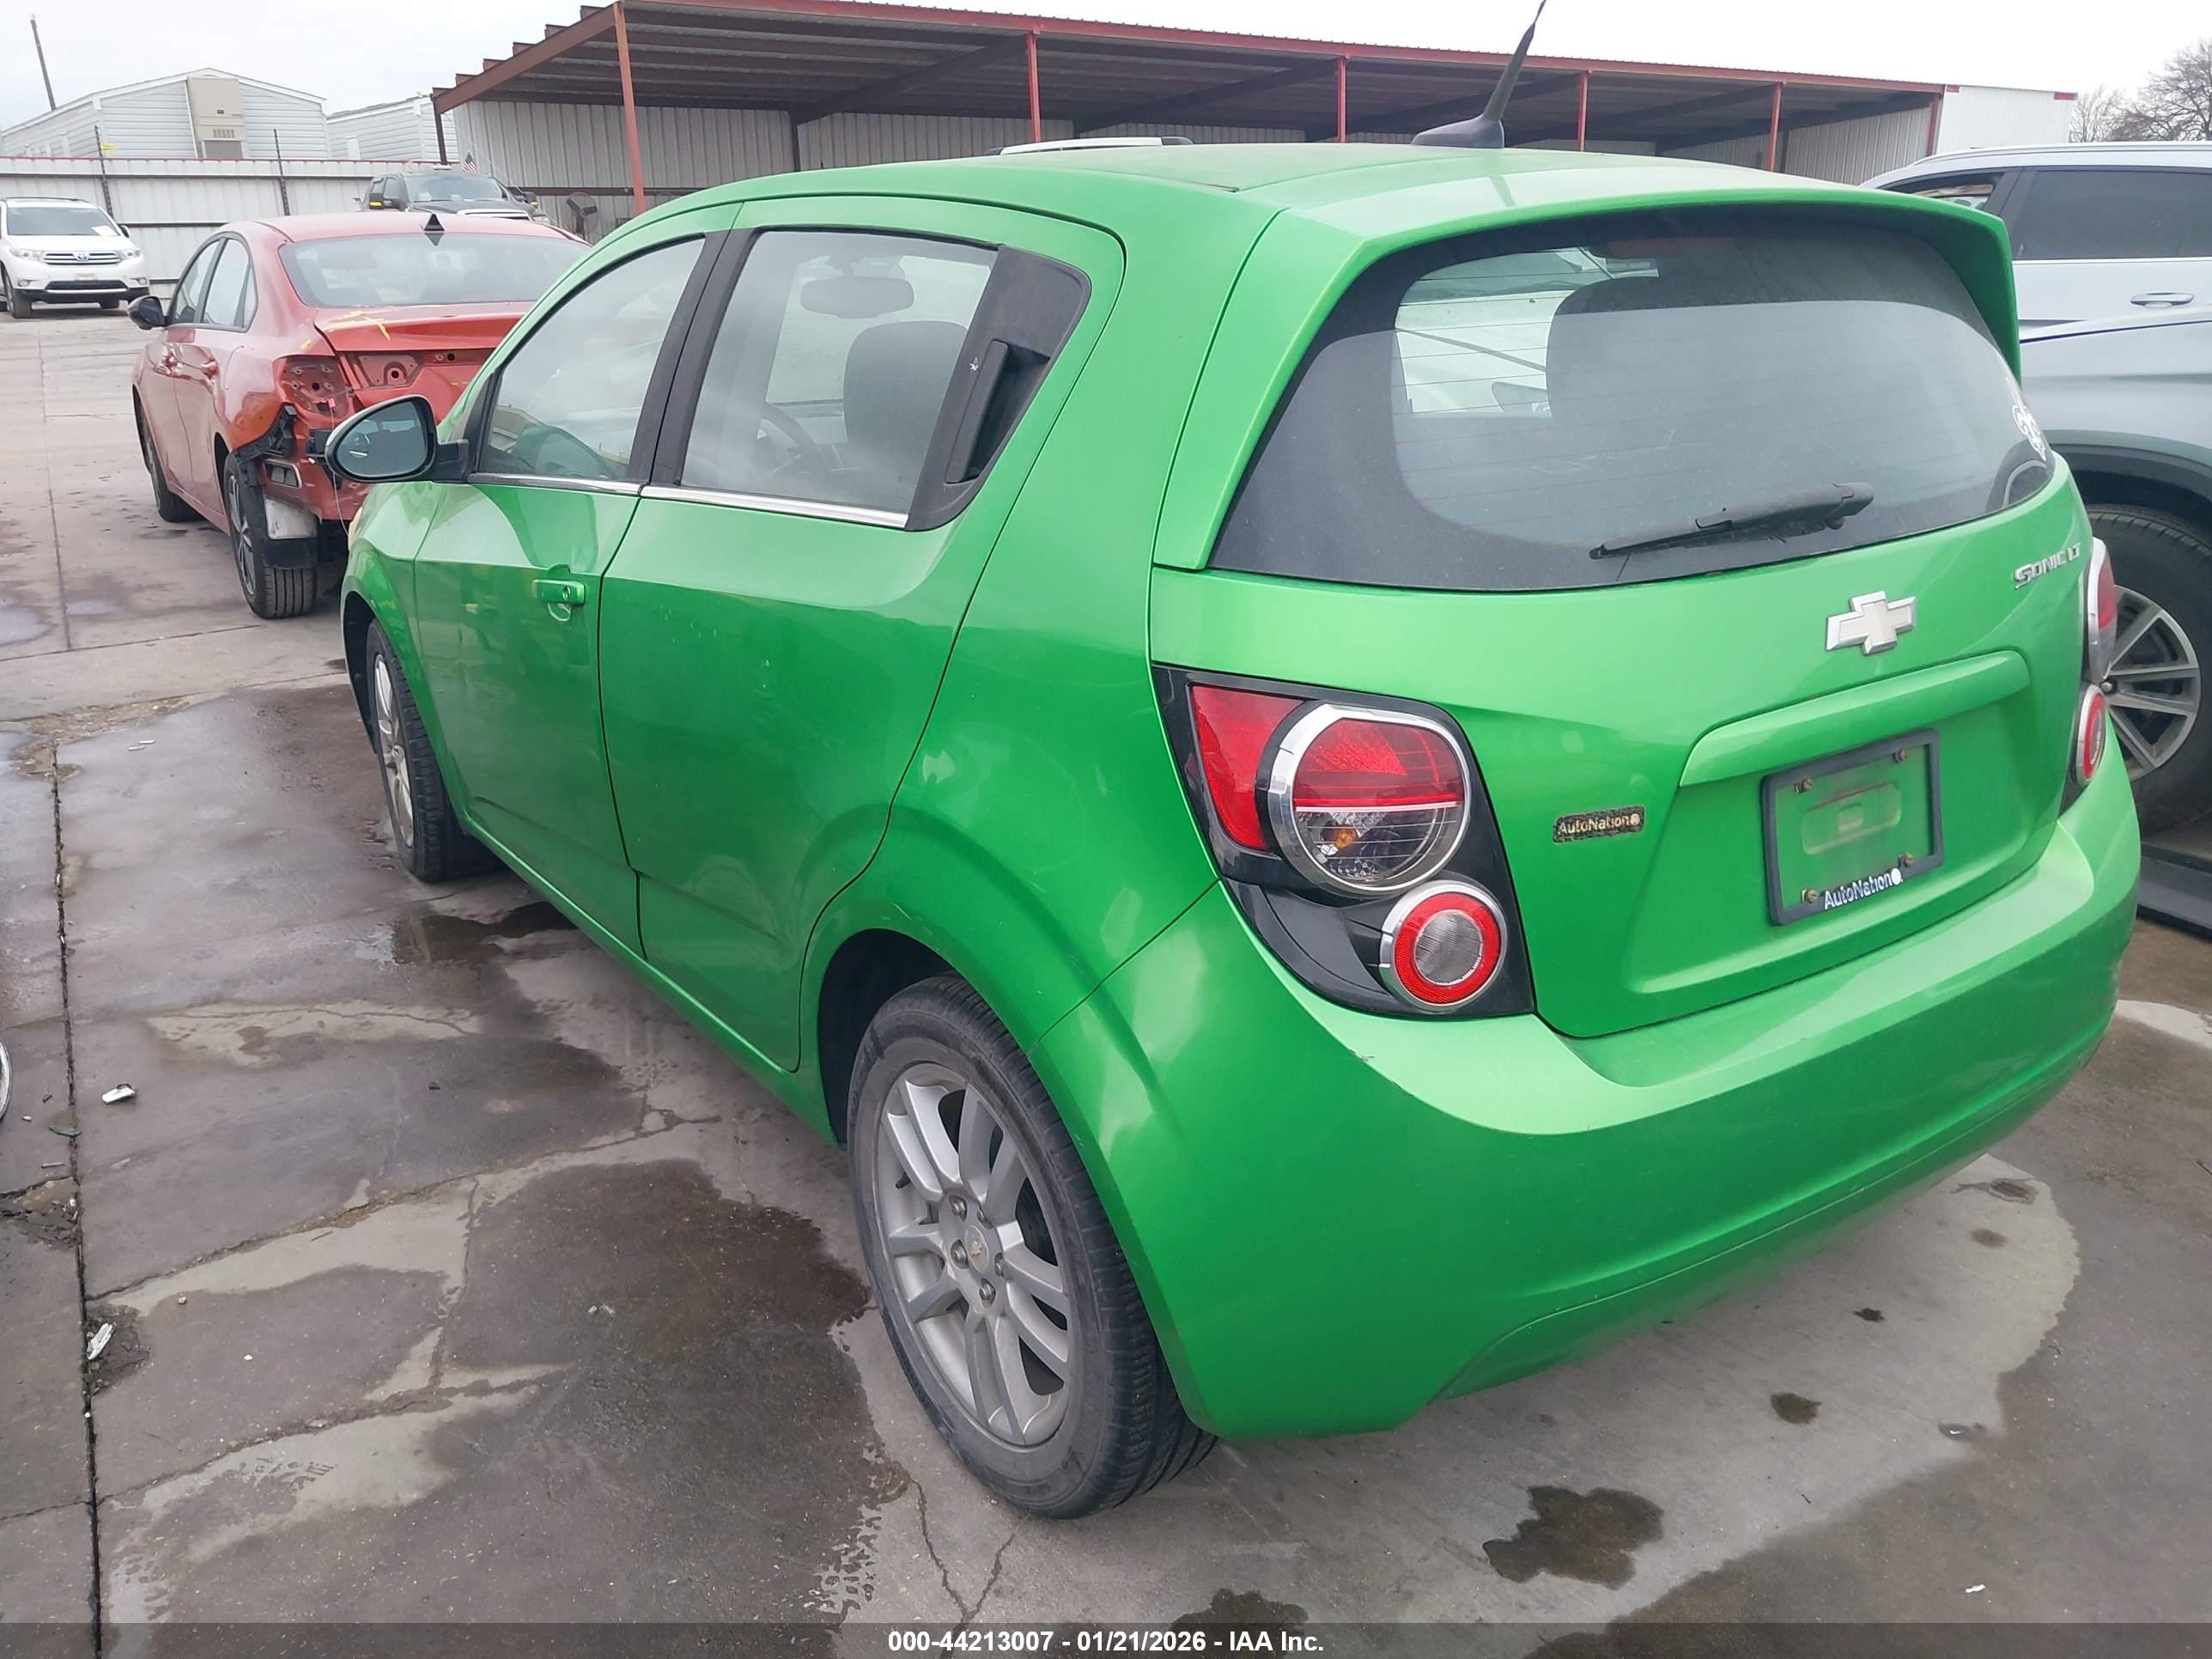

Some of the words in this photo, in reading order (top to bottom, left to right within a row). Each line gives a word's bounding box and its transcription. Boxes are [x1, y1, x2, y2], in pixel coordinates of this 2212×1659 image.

[2014, 550, 2067, 590] SONIC
[1557, 815, 1629, 836] AutoNation
[1824, 874, 1892, 910] AutoNation
